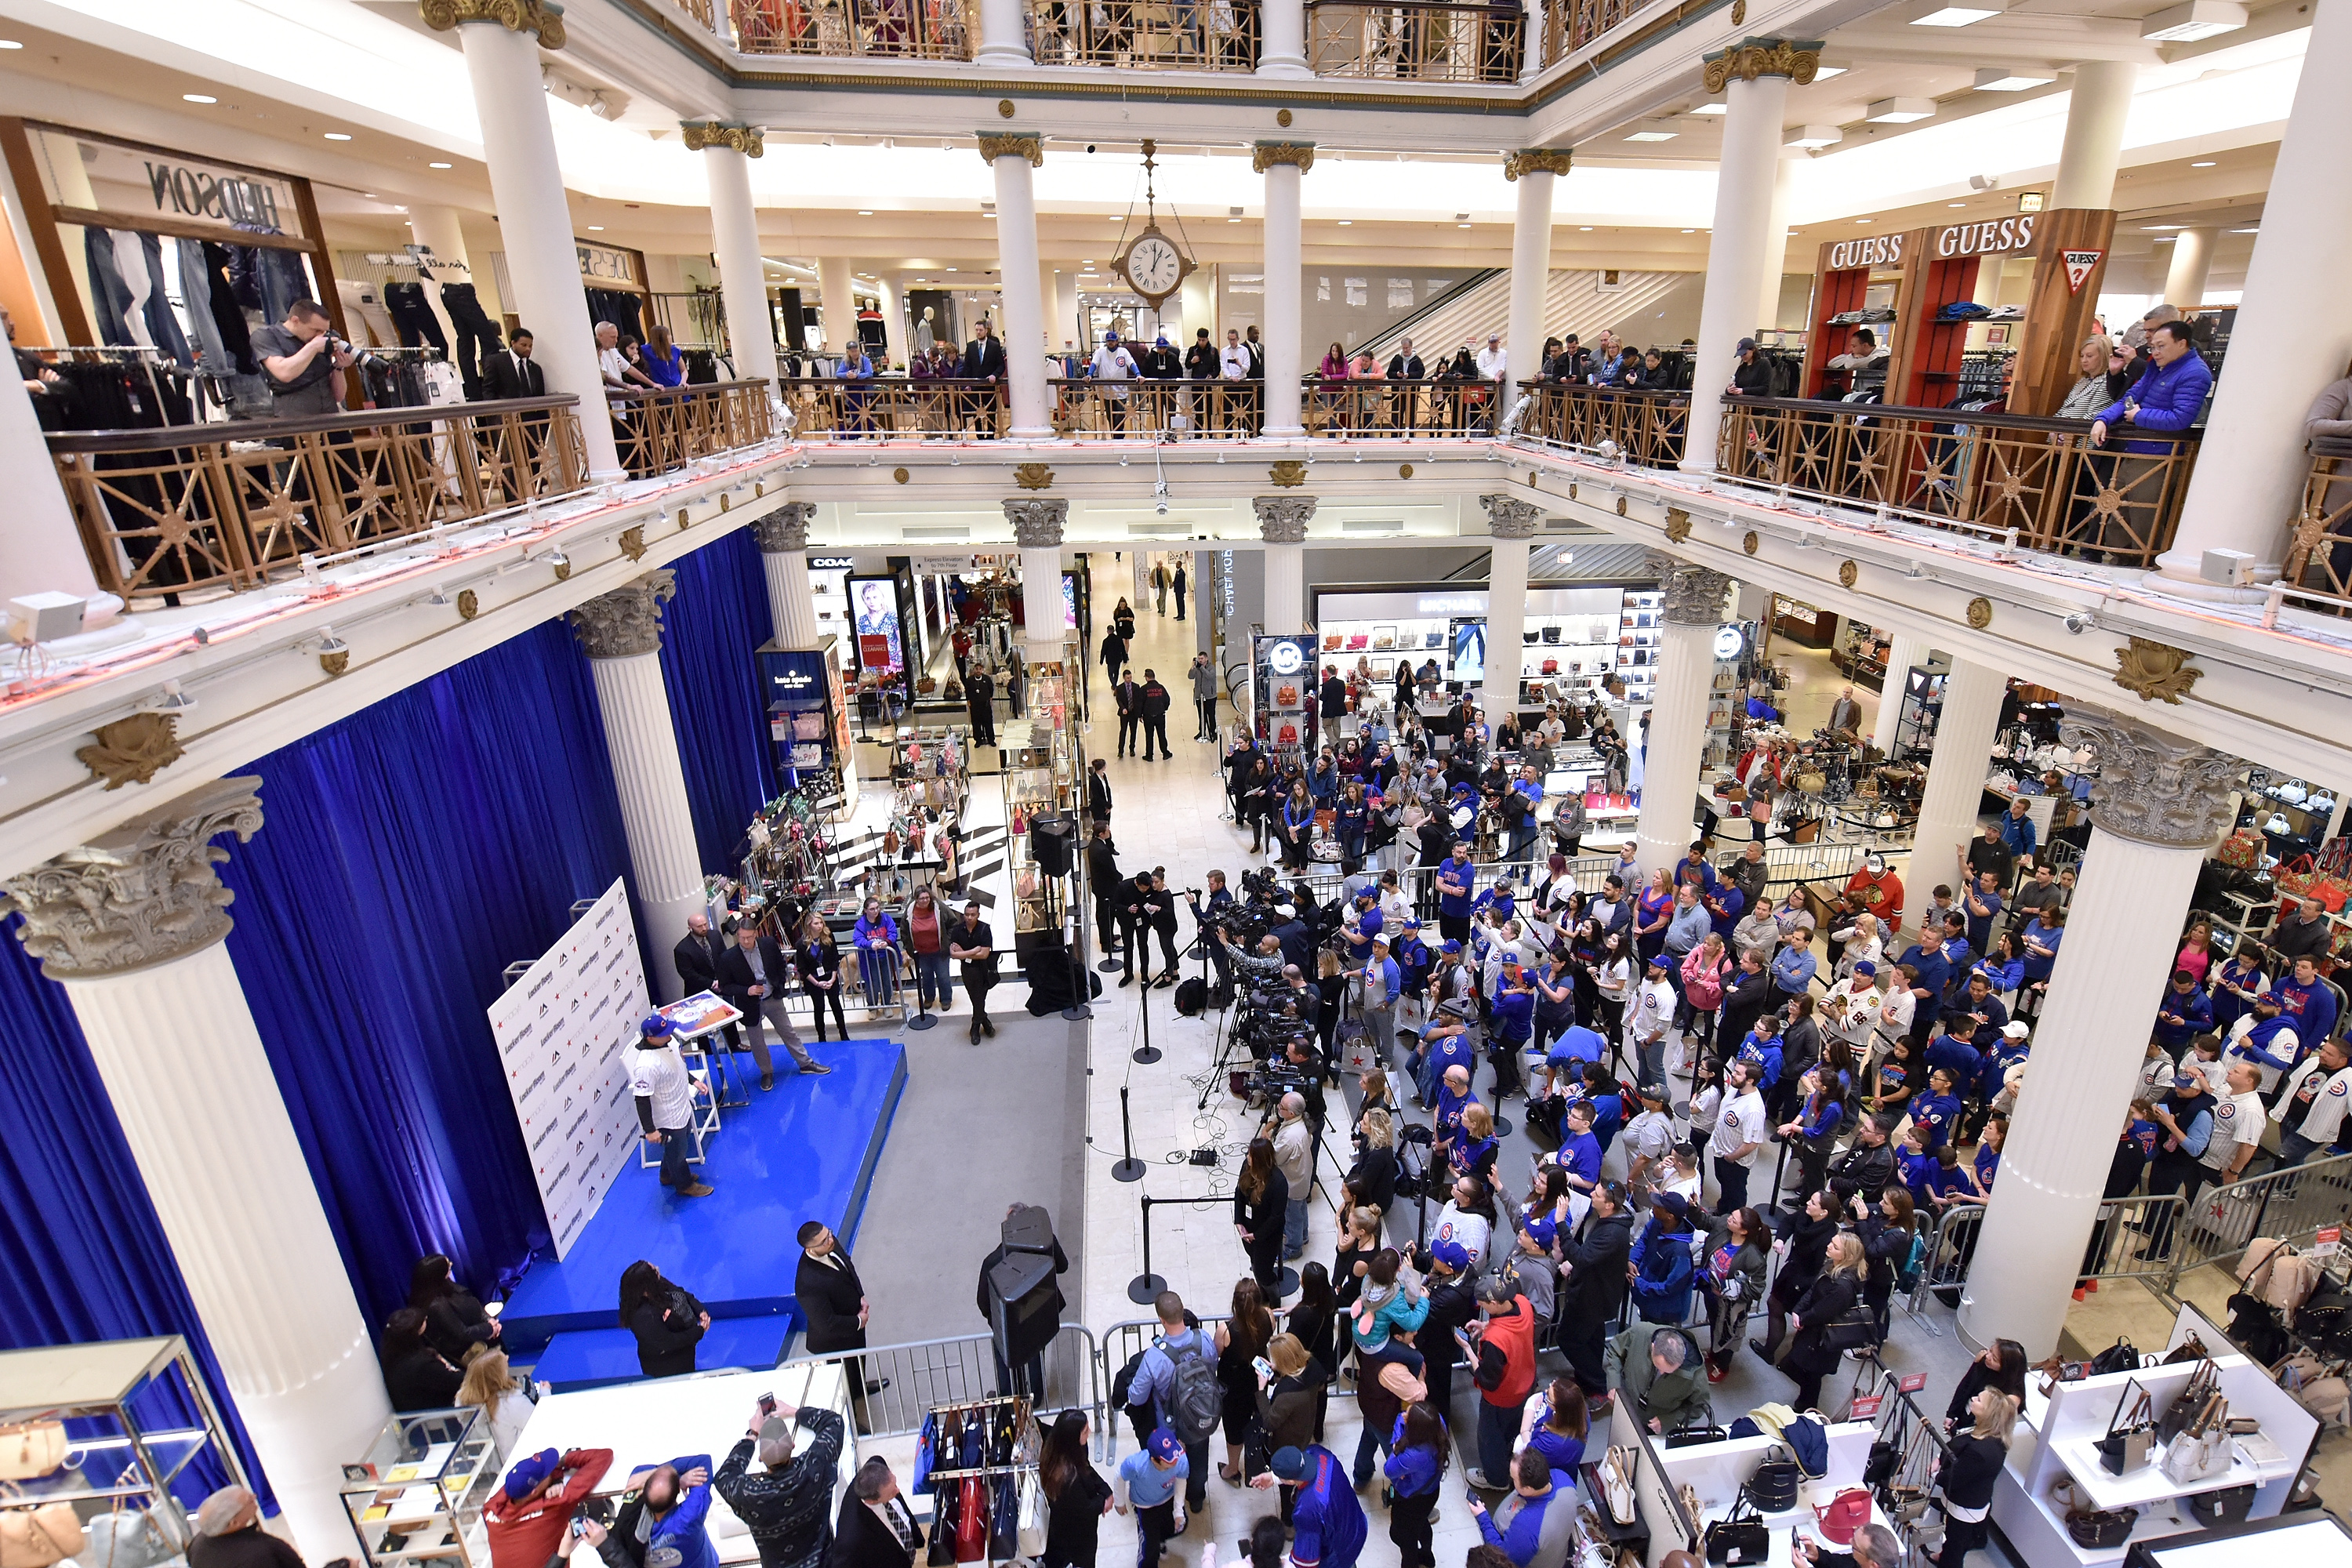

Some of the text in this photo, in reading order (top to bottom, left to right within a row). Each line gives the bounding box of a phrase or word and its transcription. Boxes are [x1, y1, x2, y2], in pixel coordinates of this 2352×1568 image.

[1939, 216, 2034, 256] GUESS
[1831, 234, 1903, 268] GUESS
[2066, 253, 2098, 265] GUESS
[1419, 599, 1483, 613] MICHAEL
[793, 753, 817, 764] HAPPY
[1852, 1011, 1867, 1026] 66
[1746, 1041, 1766, 1062] CUBS
